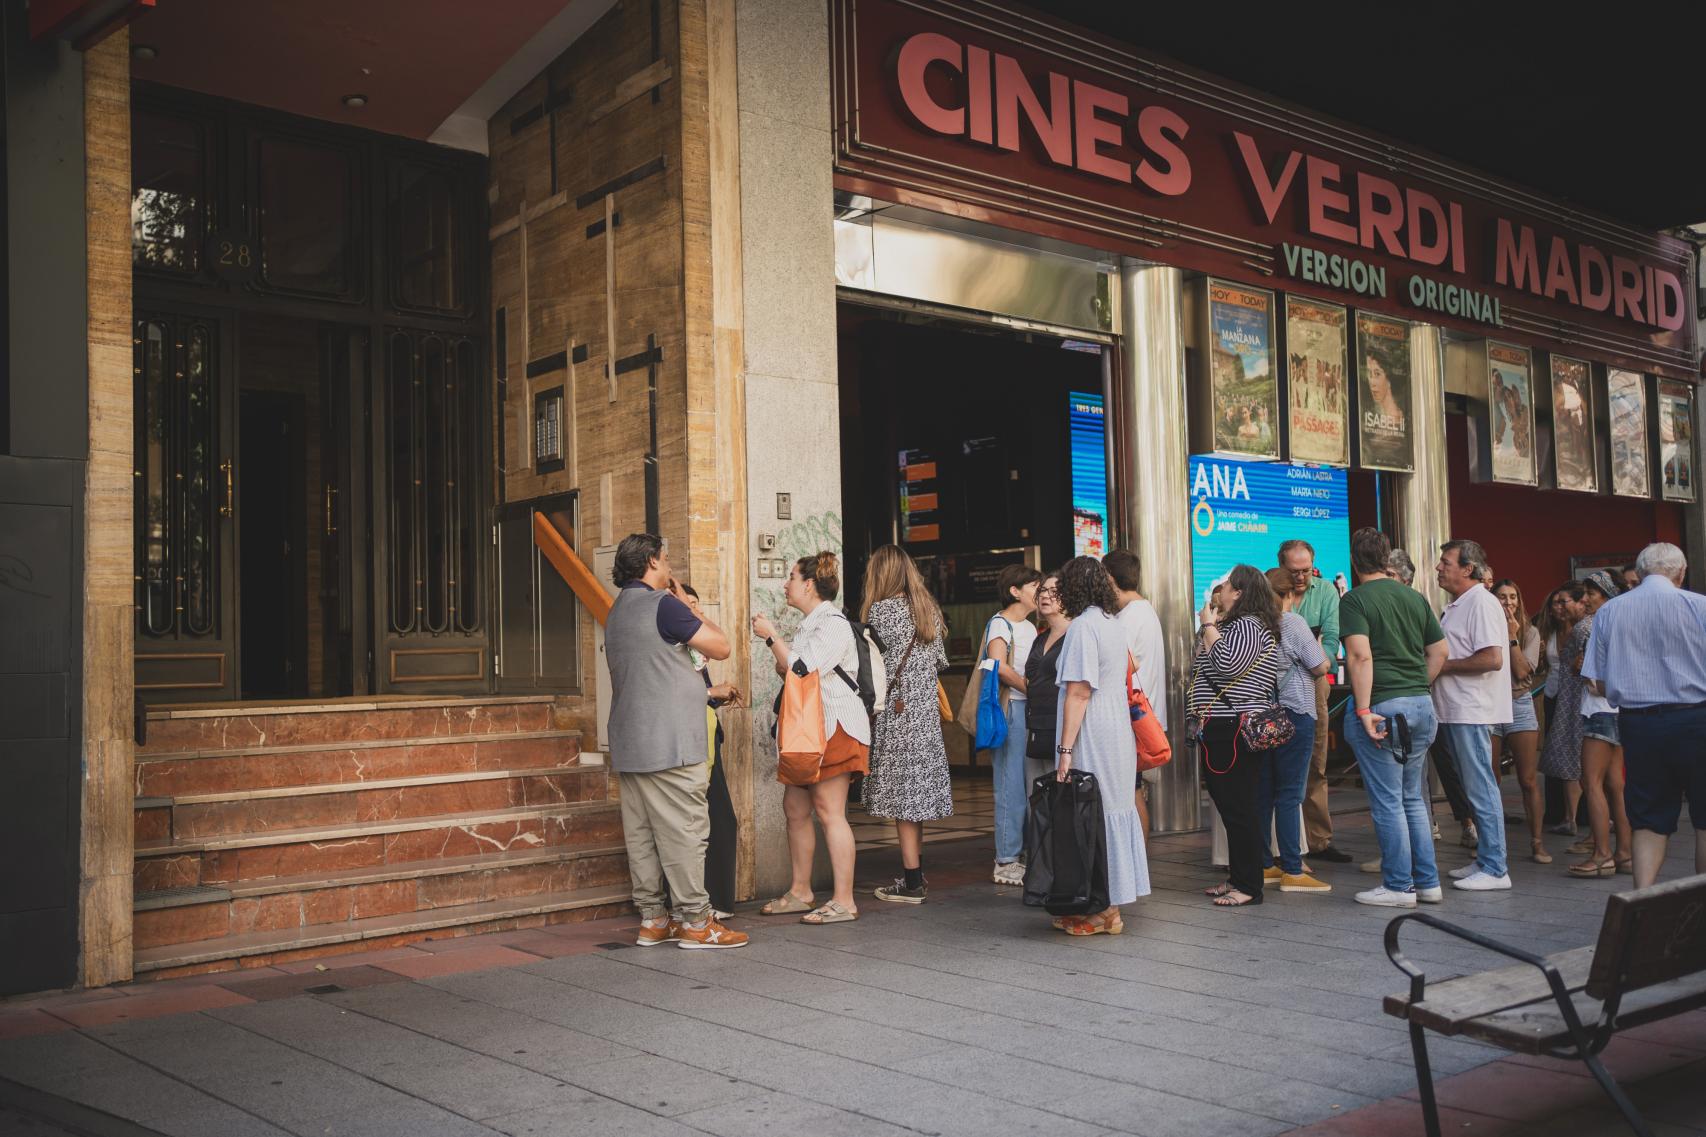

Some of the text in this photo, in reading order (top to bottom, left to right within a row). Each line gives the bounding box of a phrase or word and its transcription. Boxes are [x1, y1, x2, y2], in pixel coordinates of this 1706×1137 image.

[897, 32, 1685, 331] CINES VERDI MADRID
[220, 241, 250, 267] 28
[1283, 242, 1503, 327] VERSION ORIGINAL
[1240, 294, 1265, 308] TODAY
[1222, 329, 1261, 346] MANZANA
[1380, 325, 1403, 337] TODAY
[1364, 412, 1399, 431] ISABEL
[1191, 462, 1251, 500] ANA
